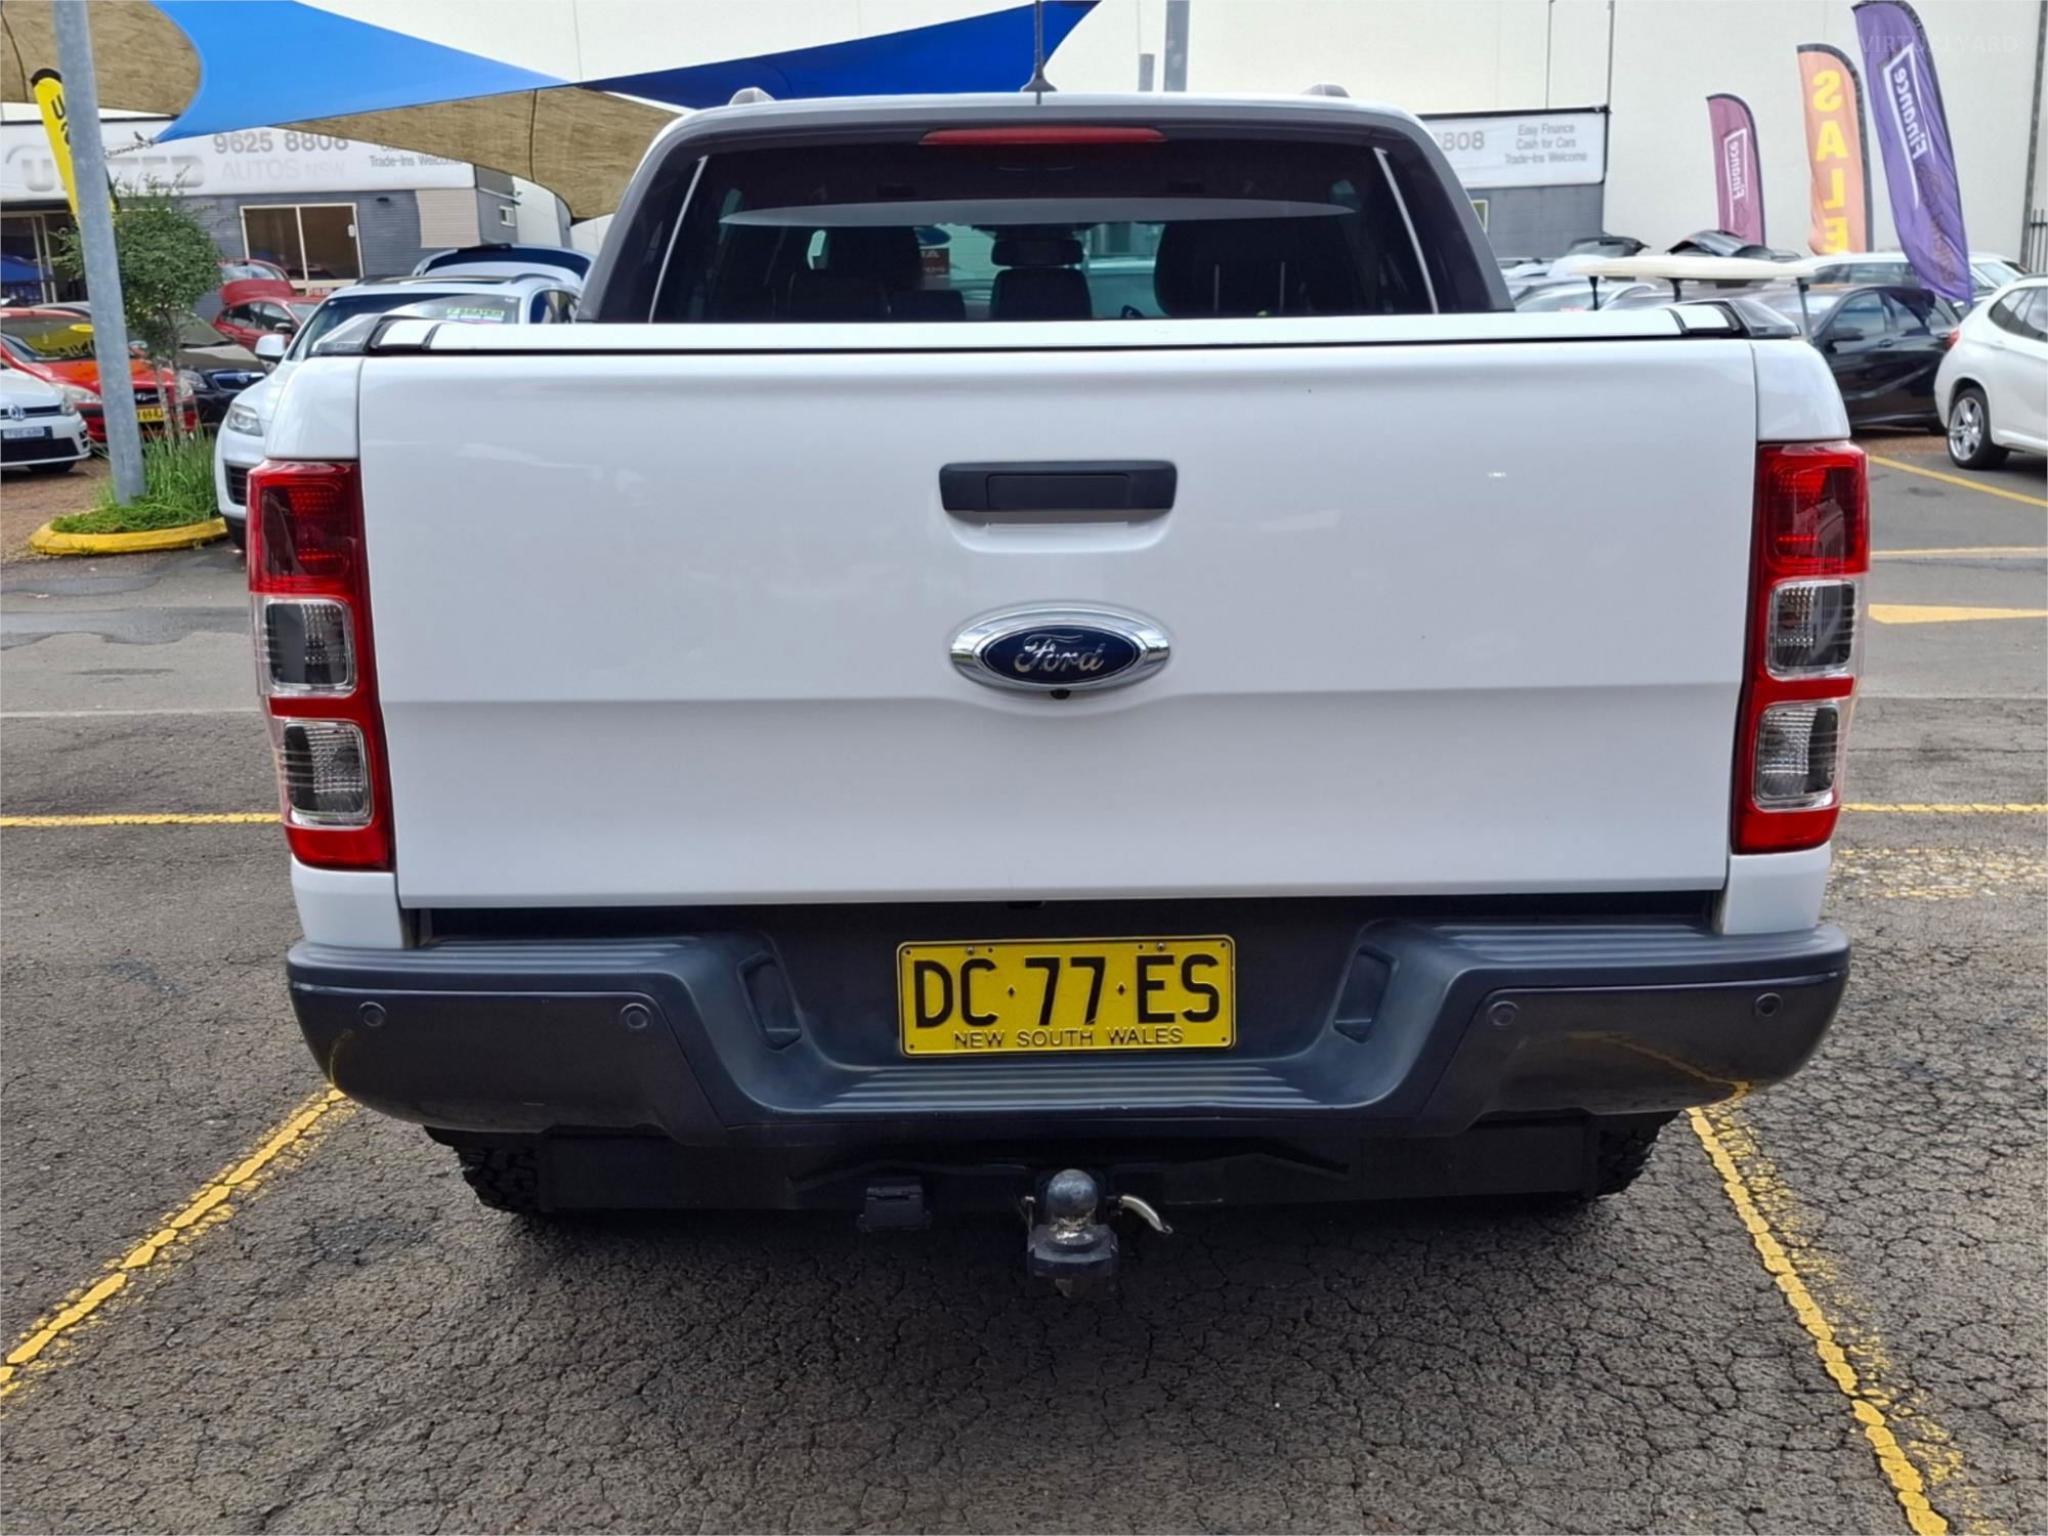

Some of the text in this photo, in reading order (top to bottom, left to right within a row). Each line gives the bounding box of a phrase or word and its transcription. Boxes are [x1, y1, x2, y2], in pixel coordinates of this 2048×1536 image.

[1541, 123, 1576, 135] Finance
[213, 131, 273, 154] 9625
[1014, 634, 1106, 673] Ford
[913, 954, 1220, 1029] DC 77 ES
[953, 1026, 1185, 1049] NEW SOUTH WALES
